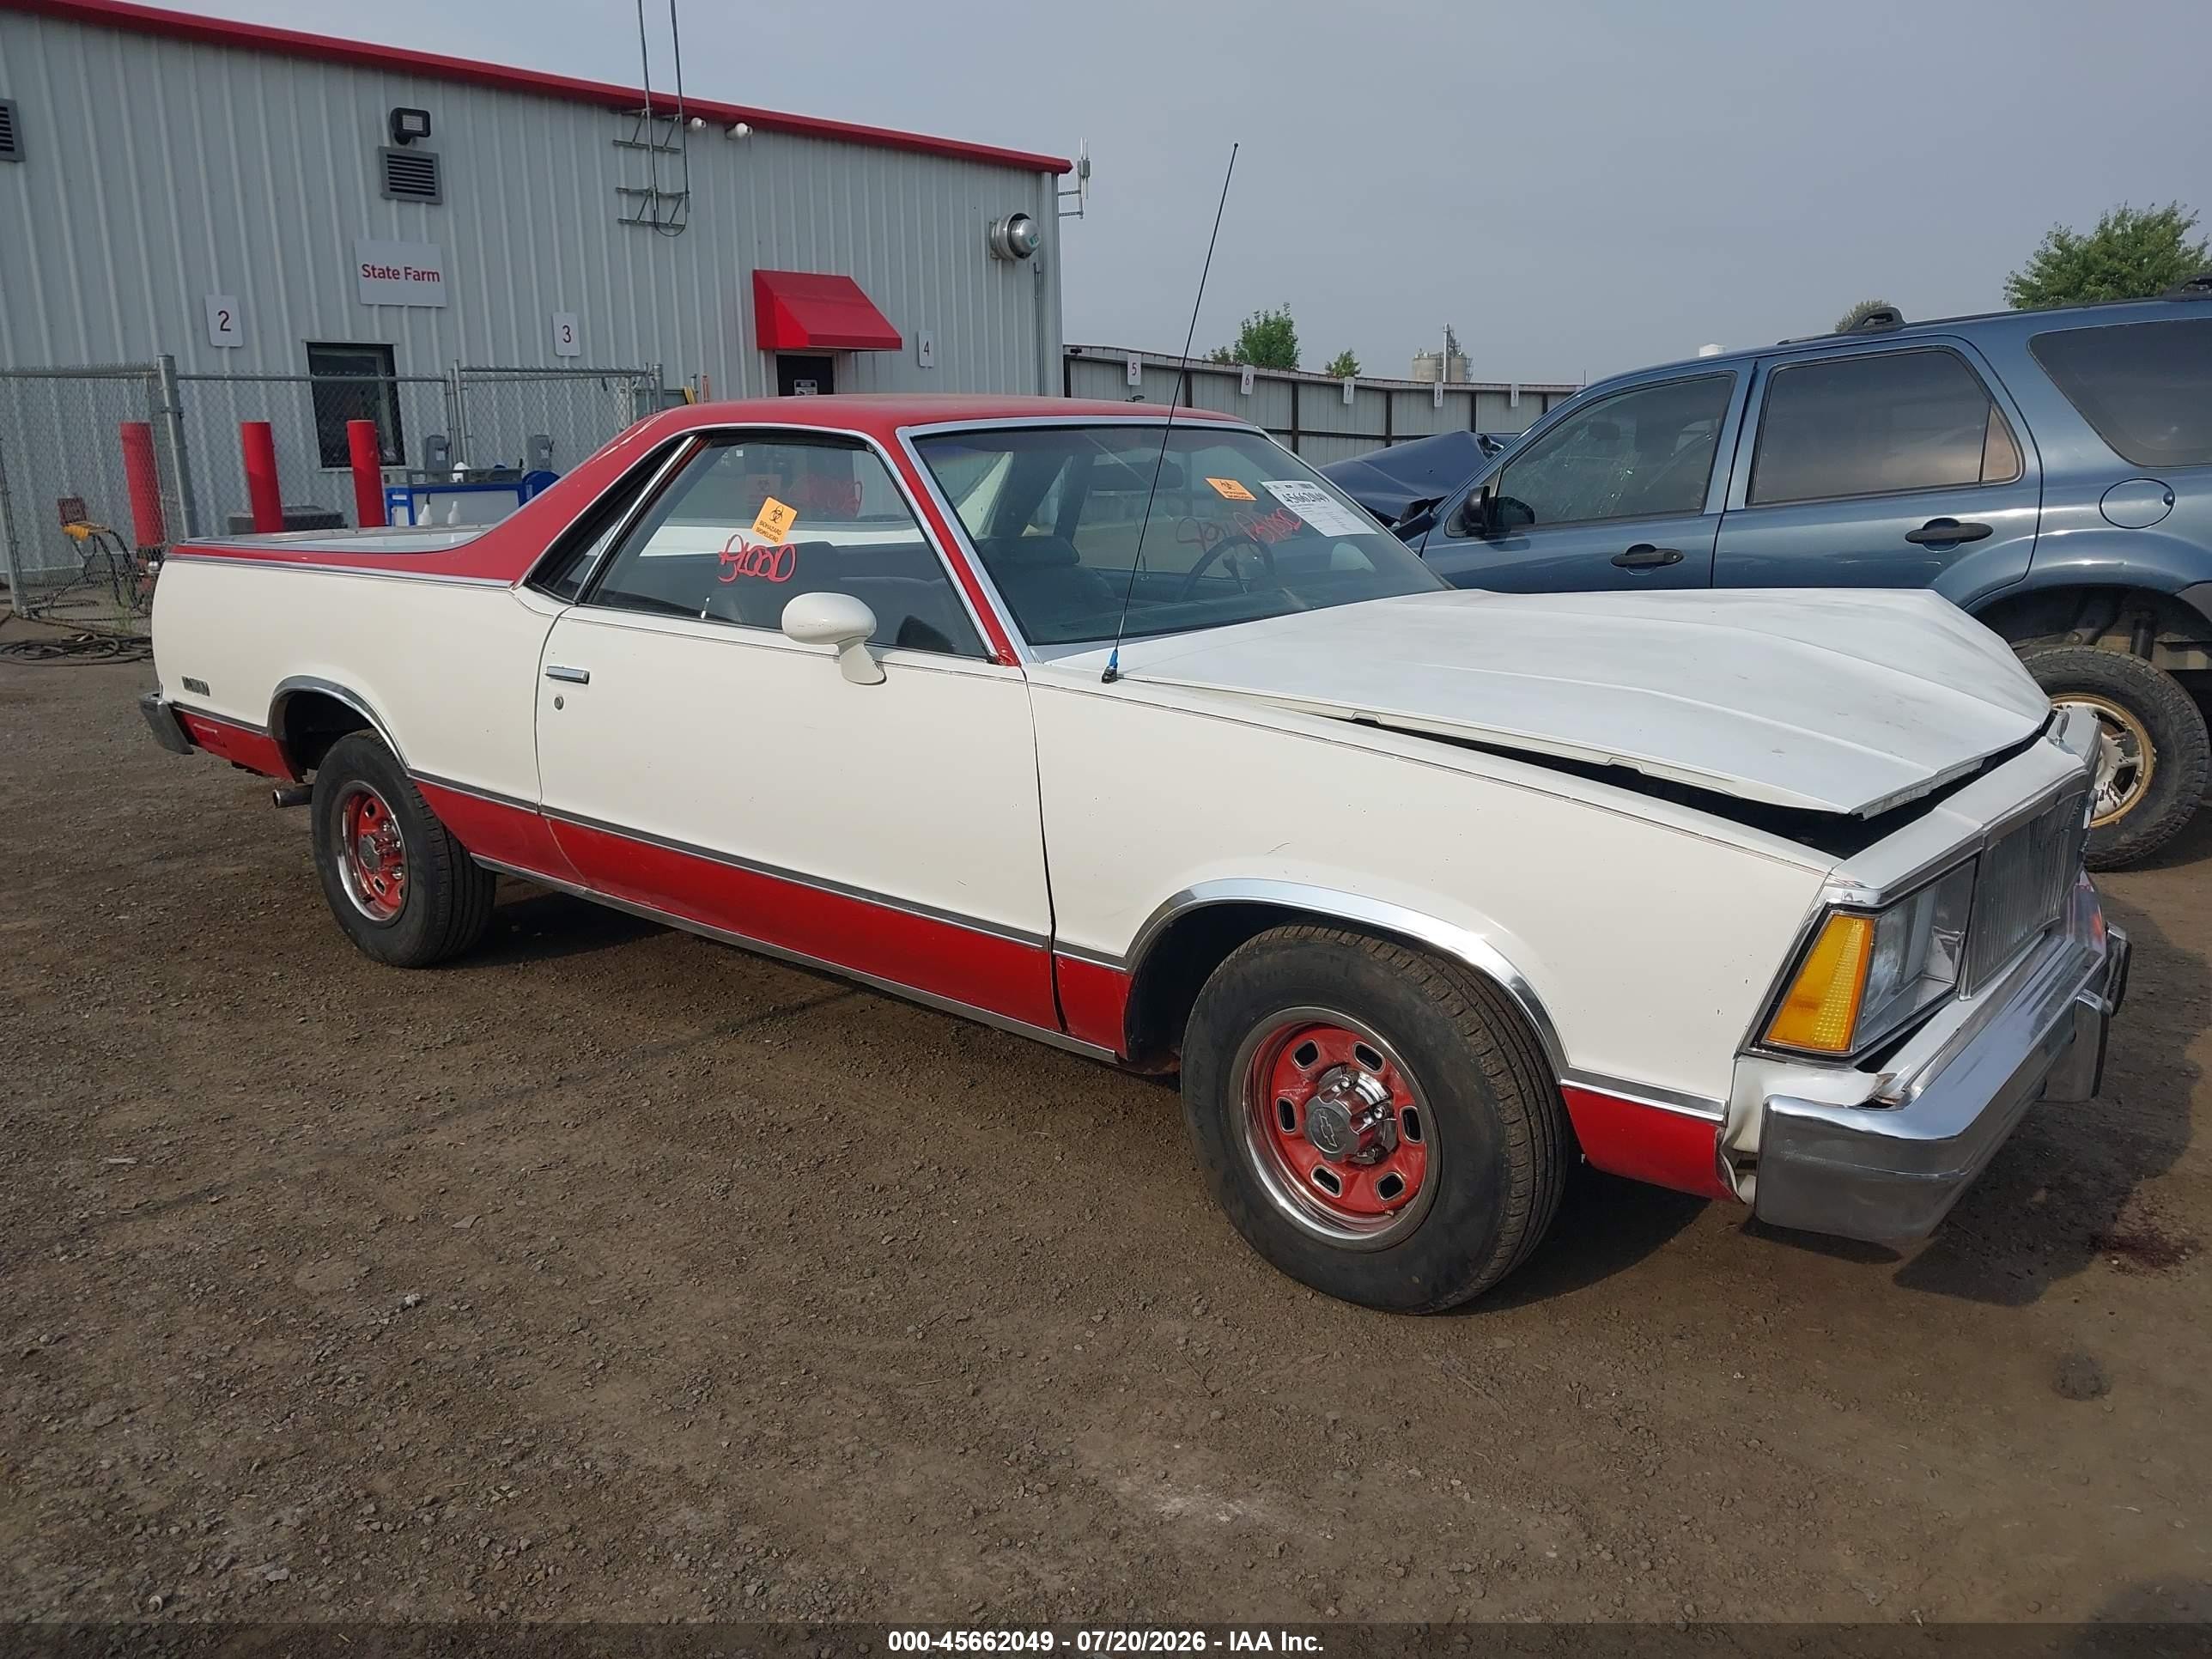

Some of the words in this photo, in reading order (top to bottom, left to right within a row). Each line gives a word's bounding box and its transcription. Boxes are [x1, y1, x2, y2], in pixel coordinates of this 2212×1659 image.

[362, 264, 400, 279] State
[404, 266, 441, 282] Farm
[218, 310, 231, 331] 2
[562, 325, 571, 343] 3
[924, 340, 929, 356] 4
[1131, 362, 1137, 376] 5
[1244, 374, 1250, 386] 6
[1346, 384, 1352, 396] 7
[1437, 389, 1442, 400] 8
[759, 520, 782, 536] BIOHAZARD
